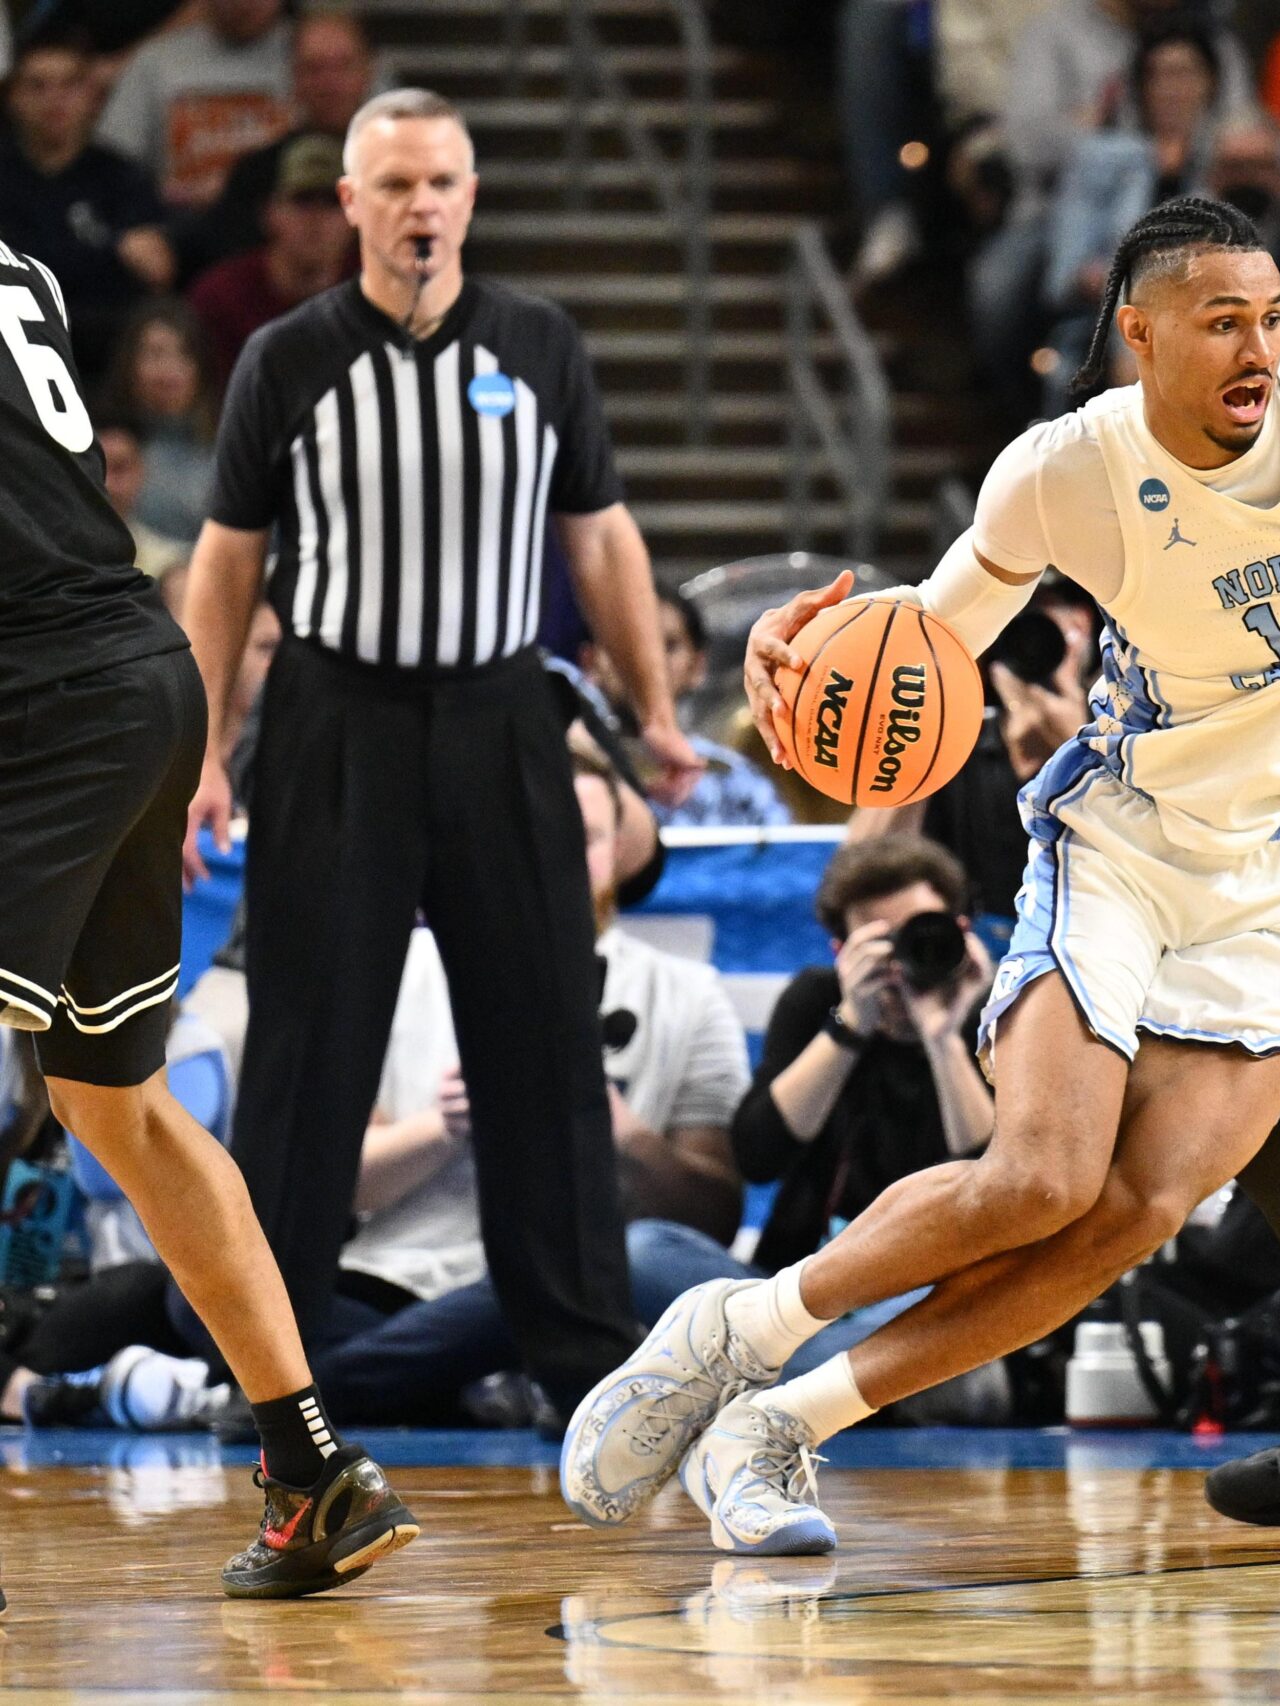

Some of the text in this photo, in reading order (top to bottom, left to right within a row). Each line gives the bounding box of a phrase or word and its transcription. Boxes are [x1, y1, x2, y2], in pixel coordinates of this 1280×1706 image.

[1143, 493, 1169, 504] NCAA
[814, 667, 855, 769] NCAA
[868, 662, 927, 793] Wilson
[872, 713, 886, 756] EVO NXT
